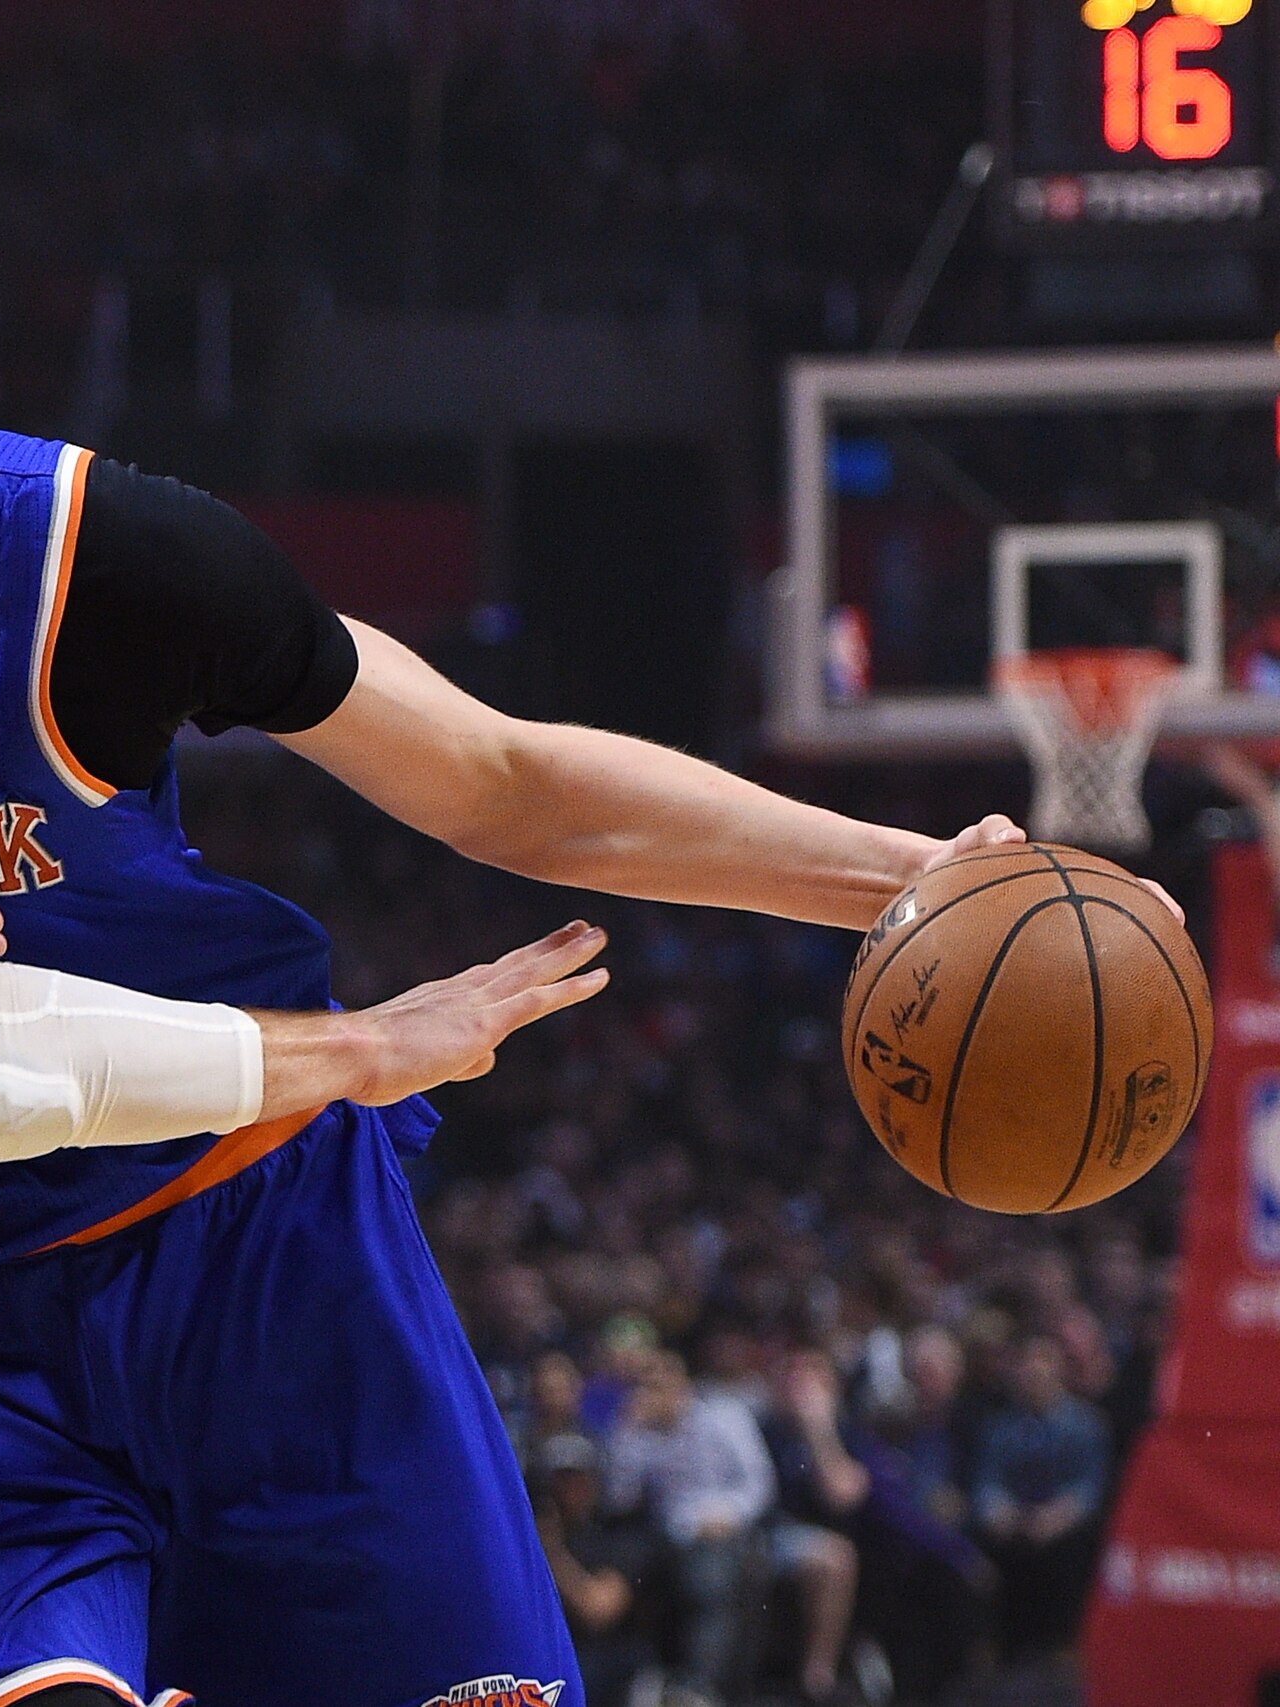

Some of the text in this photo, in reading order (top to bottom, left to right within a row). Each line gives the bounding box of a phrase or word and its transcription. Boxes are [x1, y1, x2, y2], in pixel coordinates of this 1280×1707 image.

[1103, 15, 1232, 160] 16
[450, 1682, 480, 1702] NEW
[482, 1677, 516, 1695] YORK
